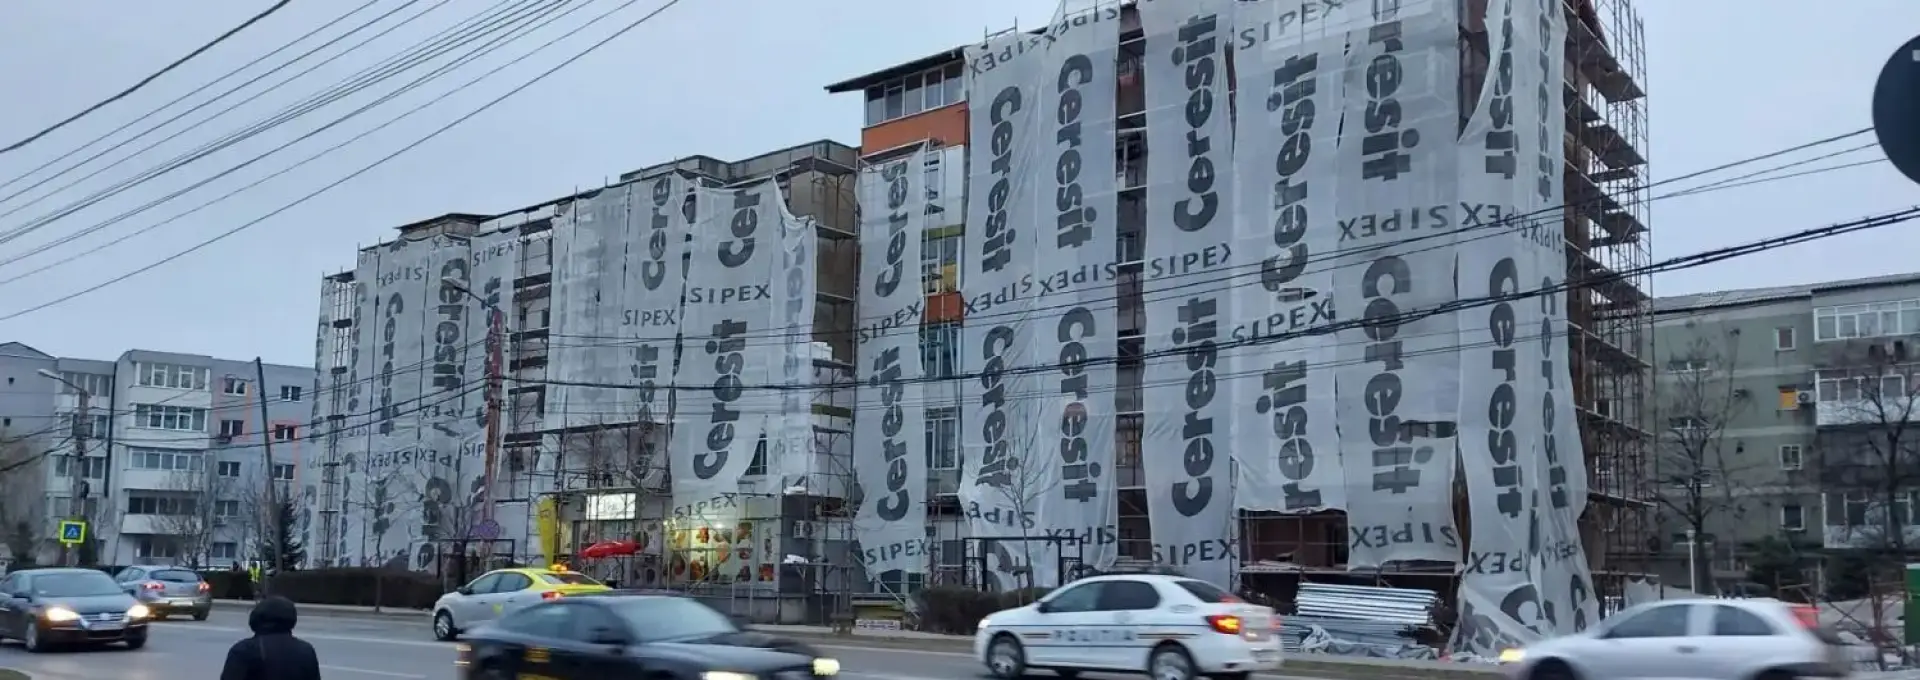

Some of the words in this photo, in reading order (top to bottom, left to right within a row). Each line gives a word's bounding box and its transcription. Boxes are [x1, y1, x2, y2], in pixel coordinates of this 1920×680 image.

[1044, 8, 1119, 50] SIPEX
[1240, 0, 1344, 50] SIPEX
[970, 36, 1040, 79] SIPEX
[1172, 13, 1218, 233] Ceresit
[1057, 54, 1097, 250] Ceresit
[1261, 52, 1318, 292] Ceresit
[982, 86, 1022, 274] Ceresit
[1338, 205, 1450, 242] SIPEX
[690, 284, 771, 305] SIPEX
[964, 275, 1032, 317] SIPEX
[1040, 262, 1119, 296] SIPEX
[622, 309, 676, 327] SIPEX
[859, 301, 921, 345] SIPEX
[1232, 299, 1331, 344] SIPEX
[1361, 255, 1434, 494] Ceresit
[1489, 257, 1523, 519] Ceresit
[693, 319, 748, 481] Ceresit
[1058, 307, 1102, 502] Ceresit
[1172, 298, 1217, 517] Ceresit
[869, 346, 910, 522] Ceresit
[674, 494, 738, 520] SIPEX
[865, 538, 930, 566] SIPEX
[1152, 538, 1238, 566] SIPEX
[1350, 522, 1457, 549] SIPEX
